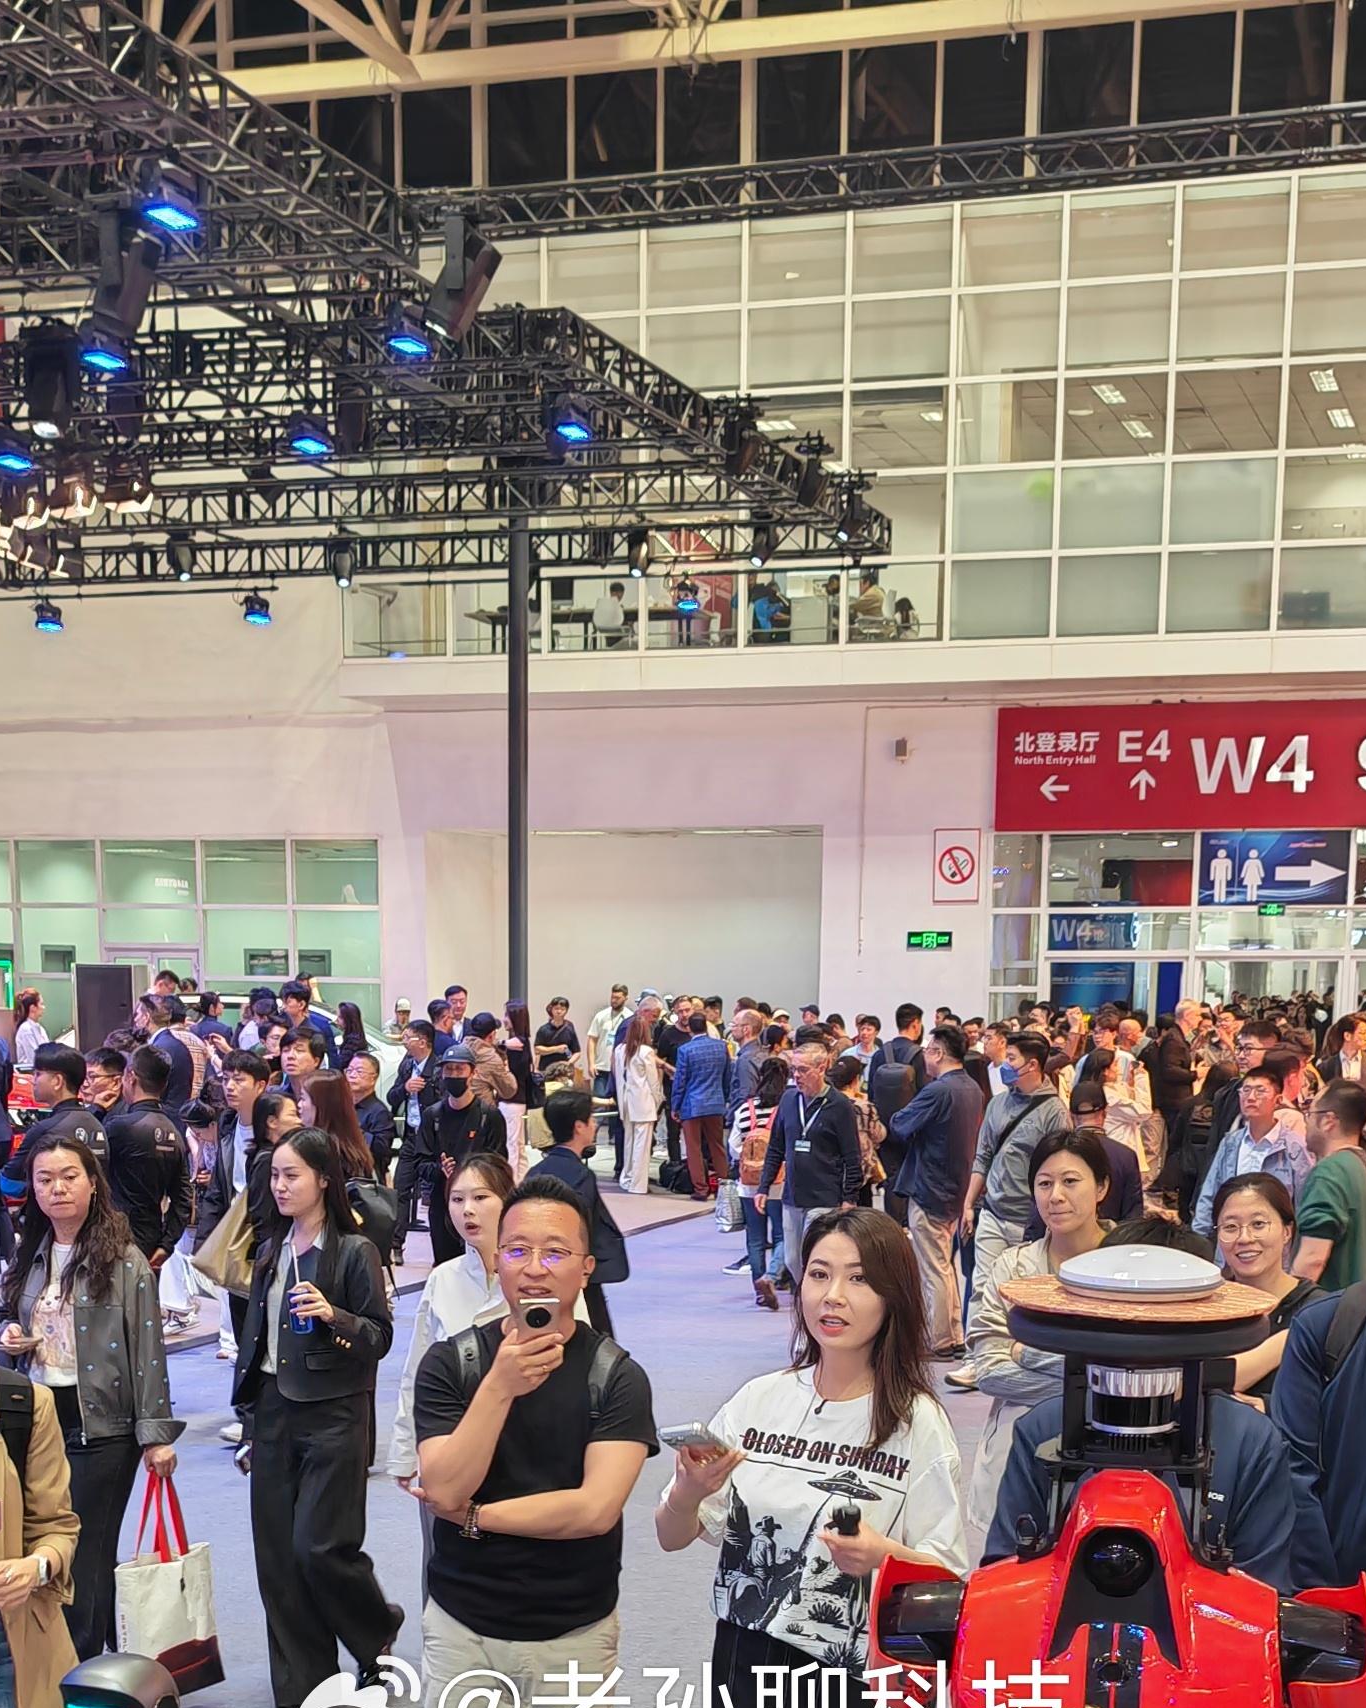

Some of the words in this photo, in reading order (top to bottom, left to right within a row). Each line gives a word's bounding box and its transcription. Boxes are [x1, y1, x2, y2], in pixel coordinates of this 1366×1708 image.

[1014, 732, 1101, 753] 北登录厅
[1118, 729, 1171, 763] E4
[1014, 755, 1044, 766] North
[1046, 755, 1073, 767] Entry
[1075, 754, 1096, 765] Hall
[1190, 735, 1314, 794] W4
[807, 1441, 836, 1464] ON
[835, 1444, 910, 1481] SUNDAY
